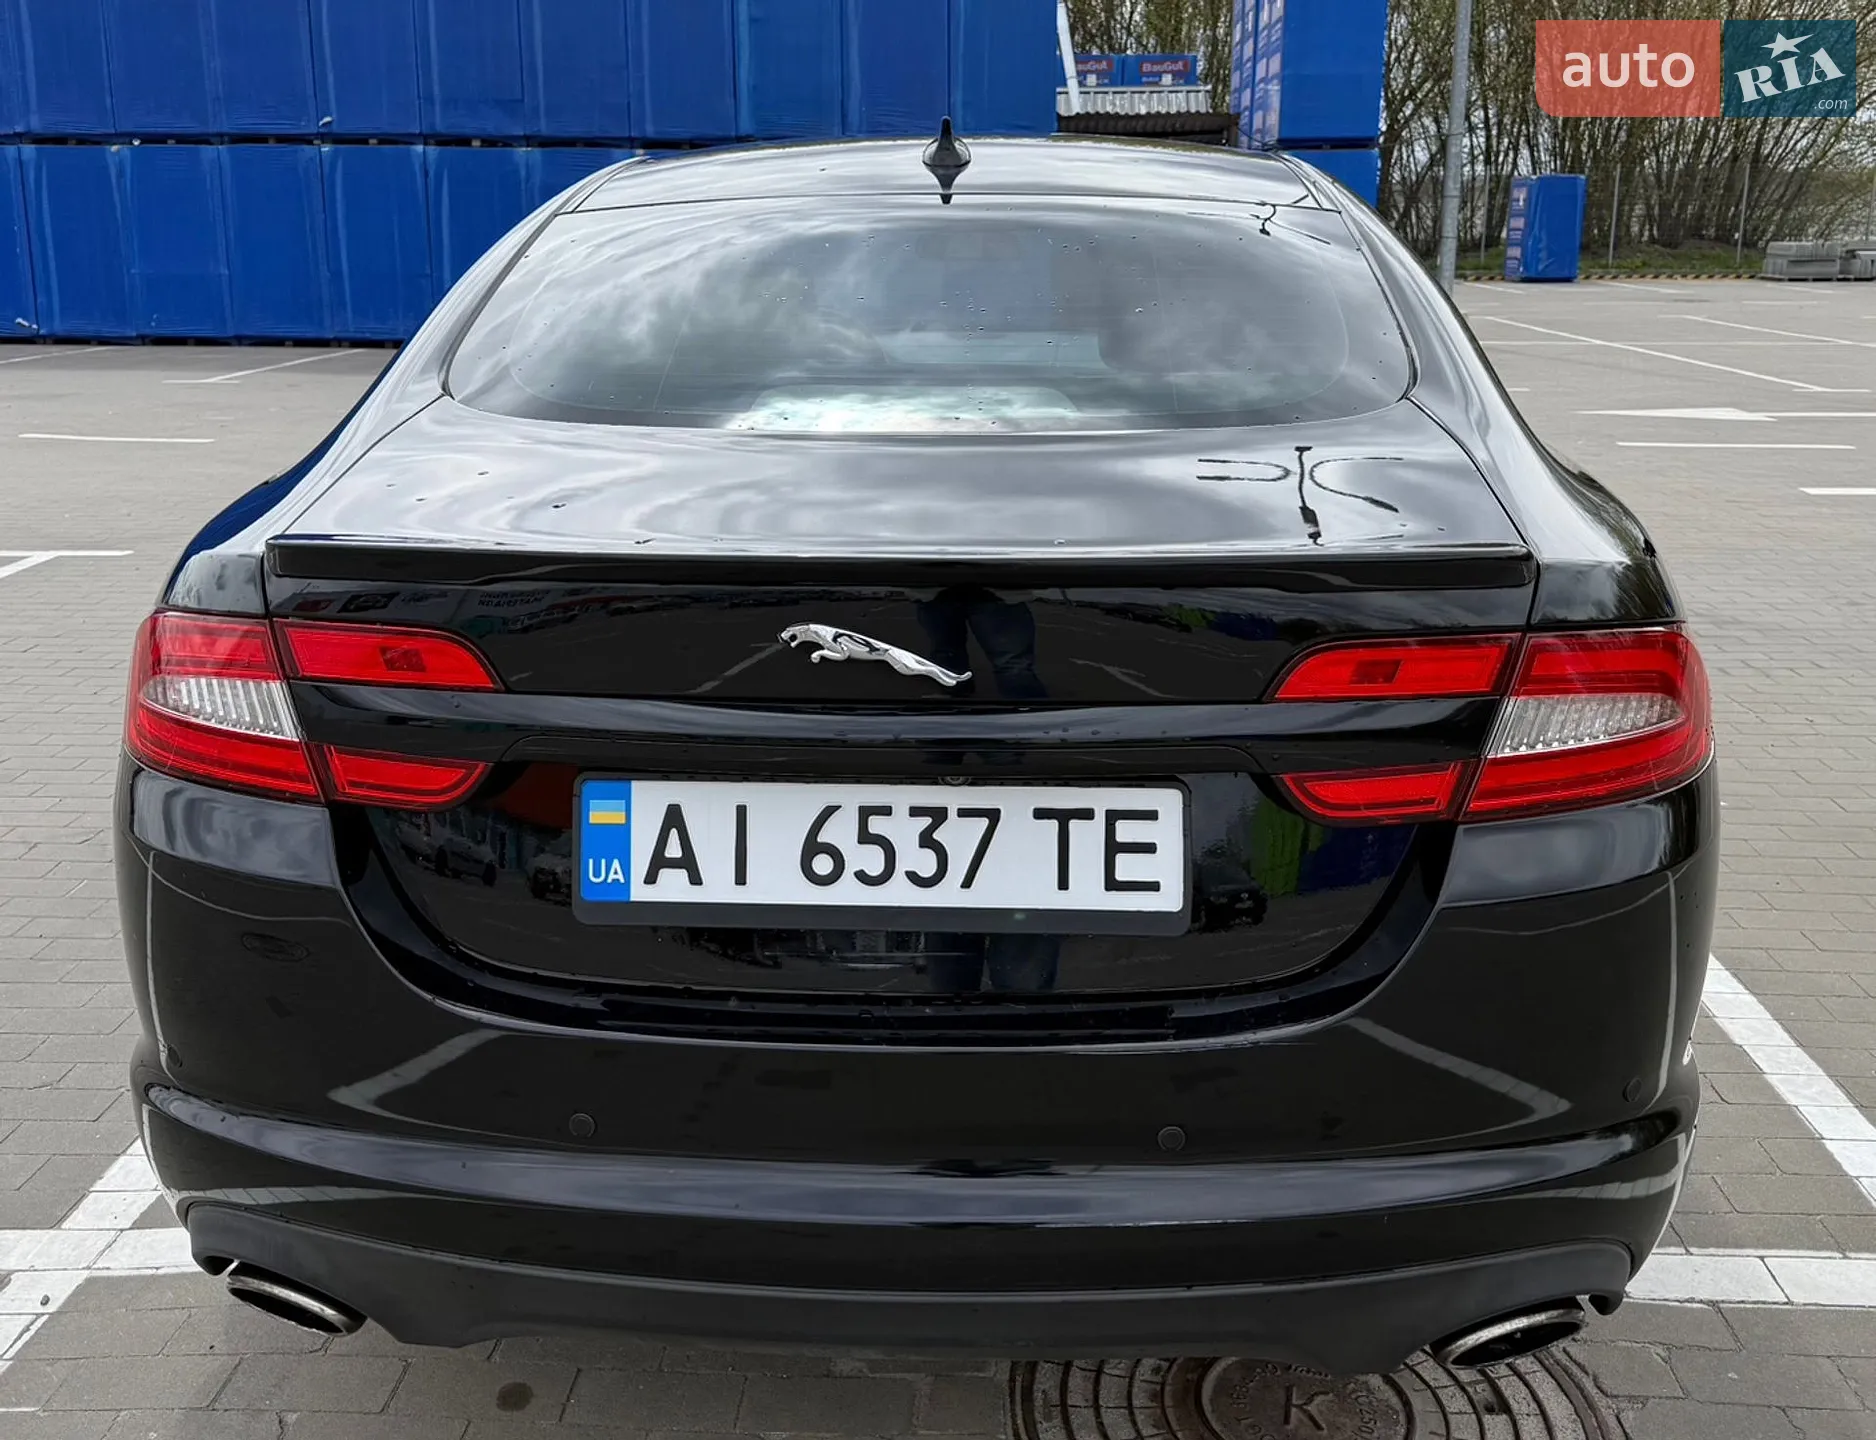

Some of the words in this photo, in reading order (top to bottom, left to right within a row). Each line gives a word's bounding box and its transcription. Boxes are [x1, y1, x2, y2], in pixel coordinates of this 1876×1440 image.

[1142, 61, 1184, 73] BauGut
[643, 803, 748, 886] AI
[800, 805, 1001, 889] 6537
[1033, 807, 1161, 892] TE
[588, 858, 625, 884] UA
